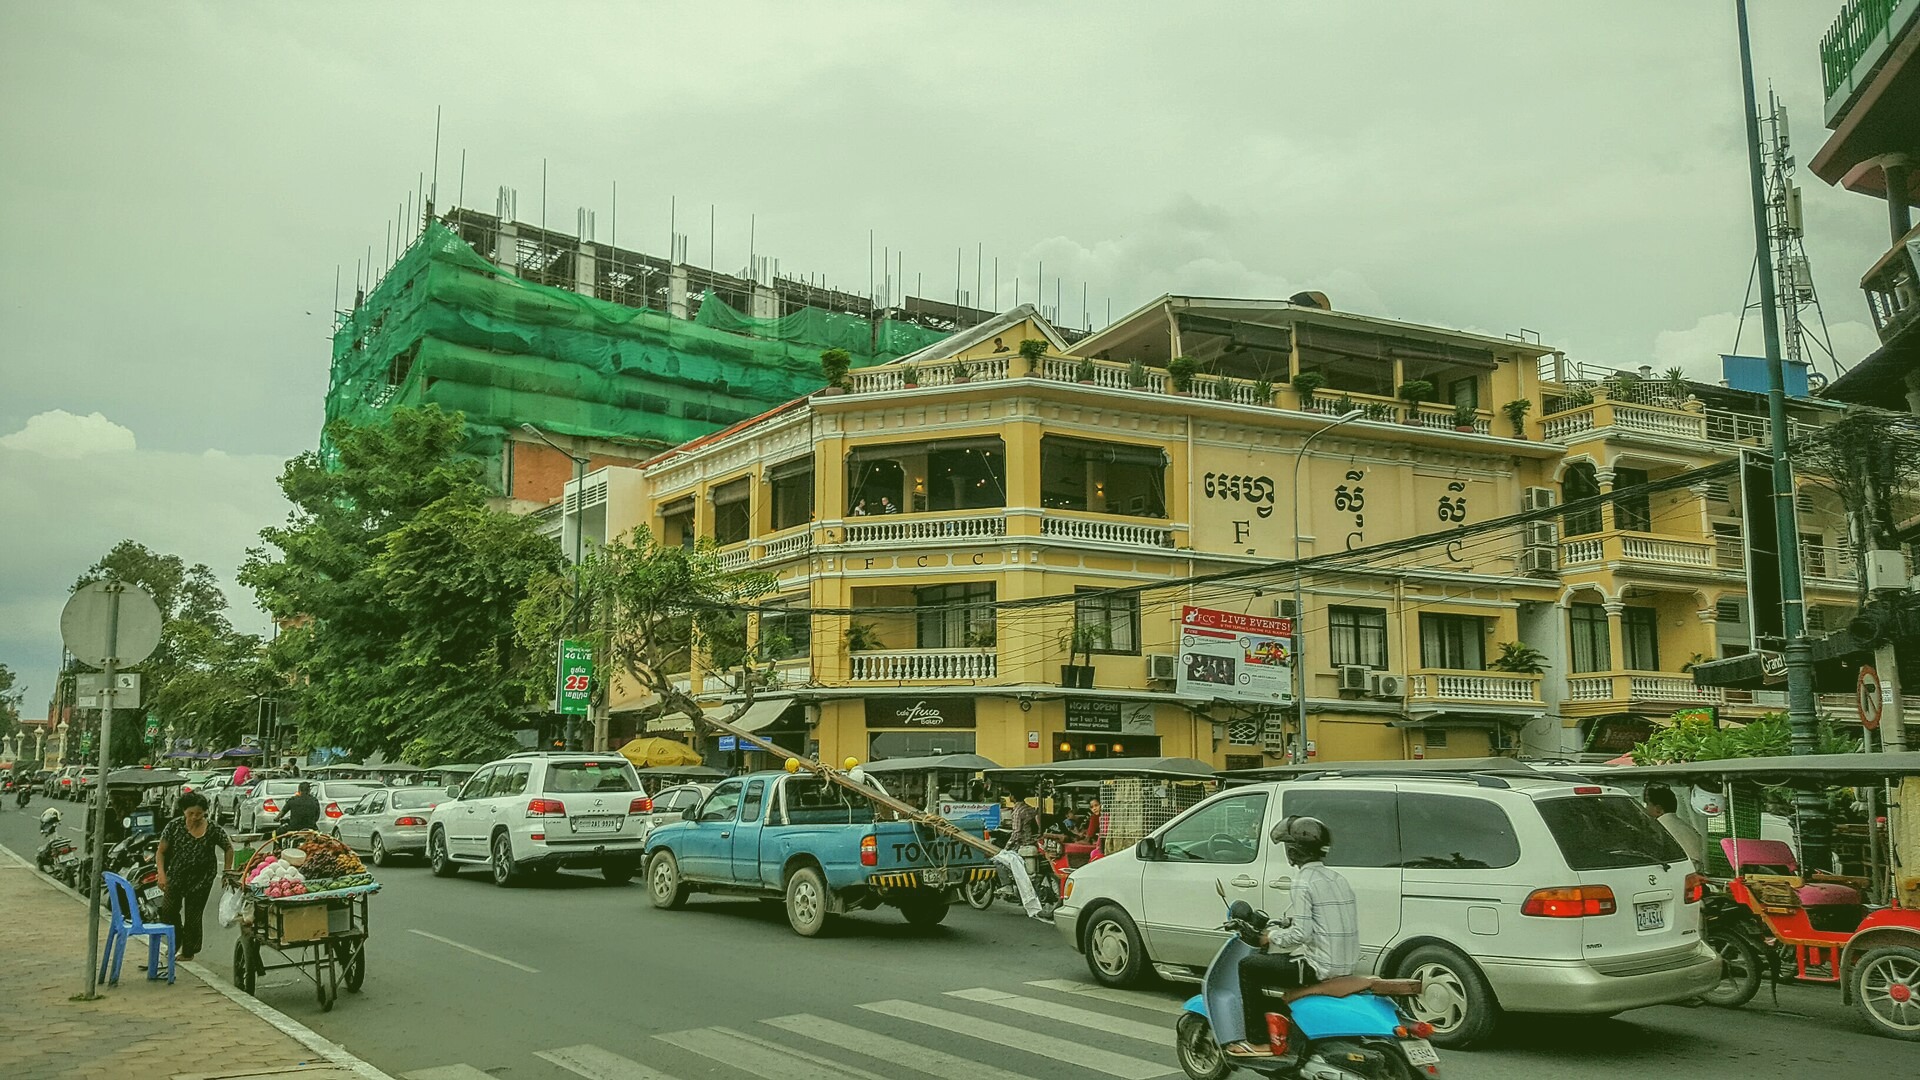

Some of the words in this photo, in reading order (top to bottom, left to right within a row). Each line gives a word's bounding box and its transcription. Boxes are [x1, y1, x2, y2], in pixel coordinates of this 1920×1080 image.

[1232, 520, 1250, 545] F
[1446, 540, 1463, 562] C
[864, 557, 874, 569] F
[917, 555, 928, 567] C
[972, 552, 984, 565] C
[1198, 613, 1216, 624] FCC
[1220, 614, 1247, 626] LIVE
[1250, 617, 1291, 632] EVENTS!
[1761, 653, 1783, 673] Grand
[564, 675, 590, 691] 25
[1069, 701, 1091, 711] NOW
[892, 841, 973, 863] TOYOTA
